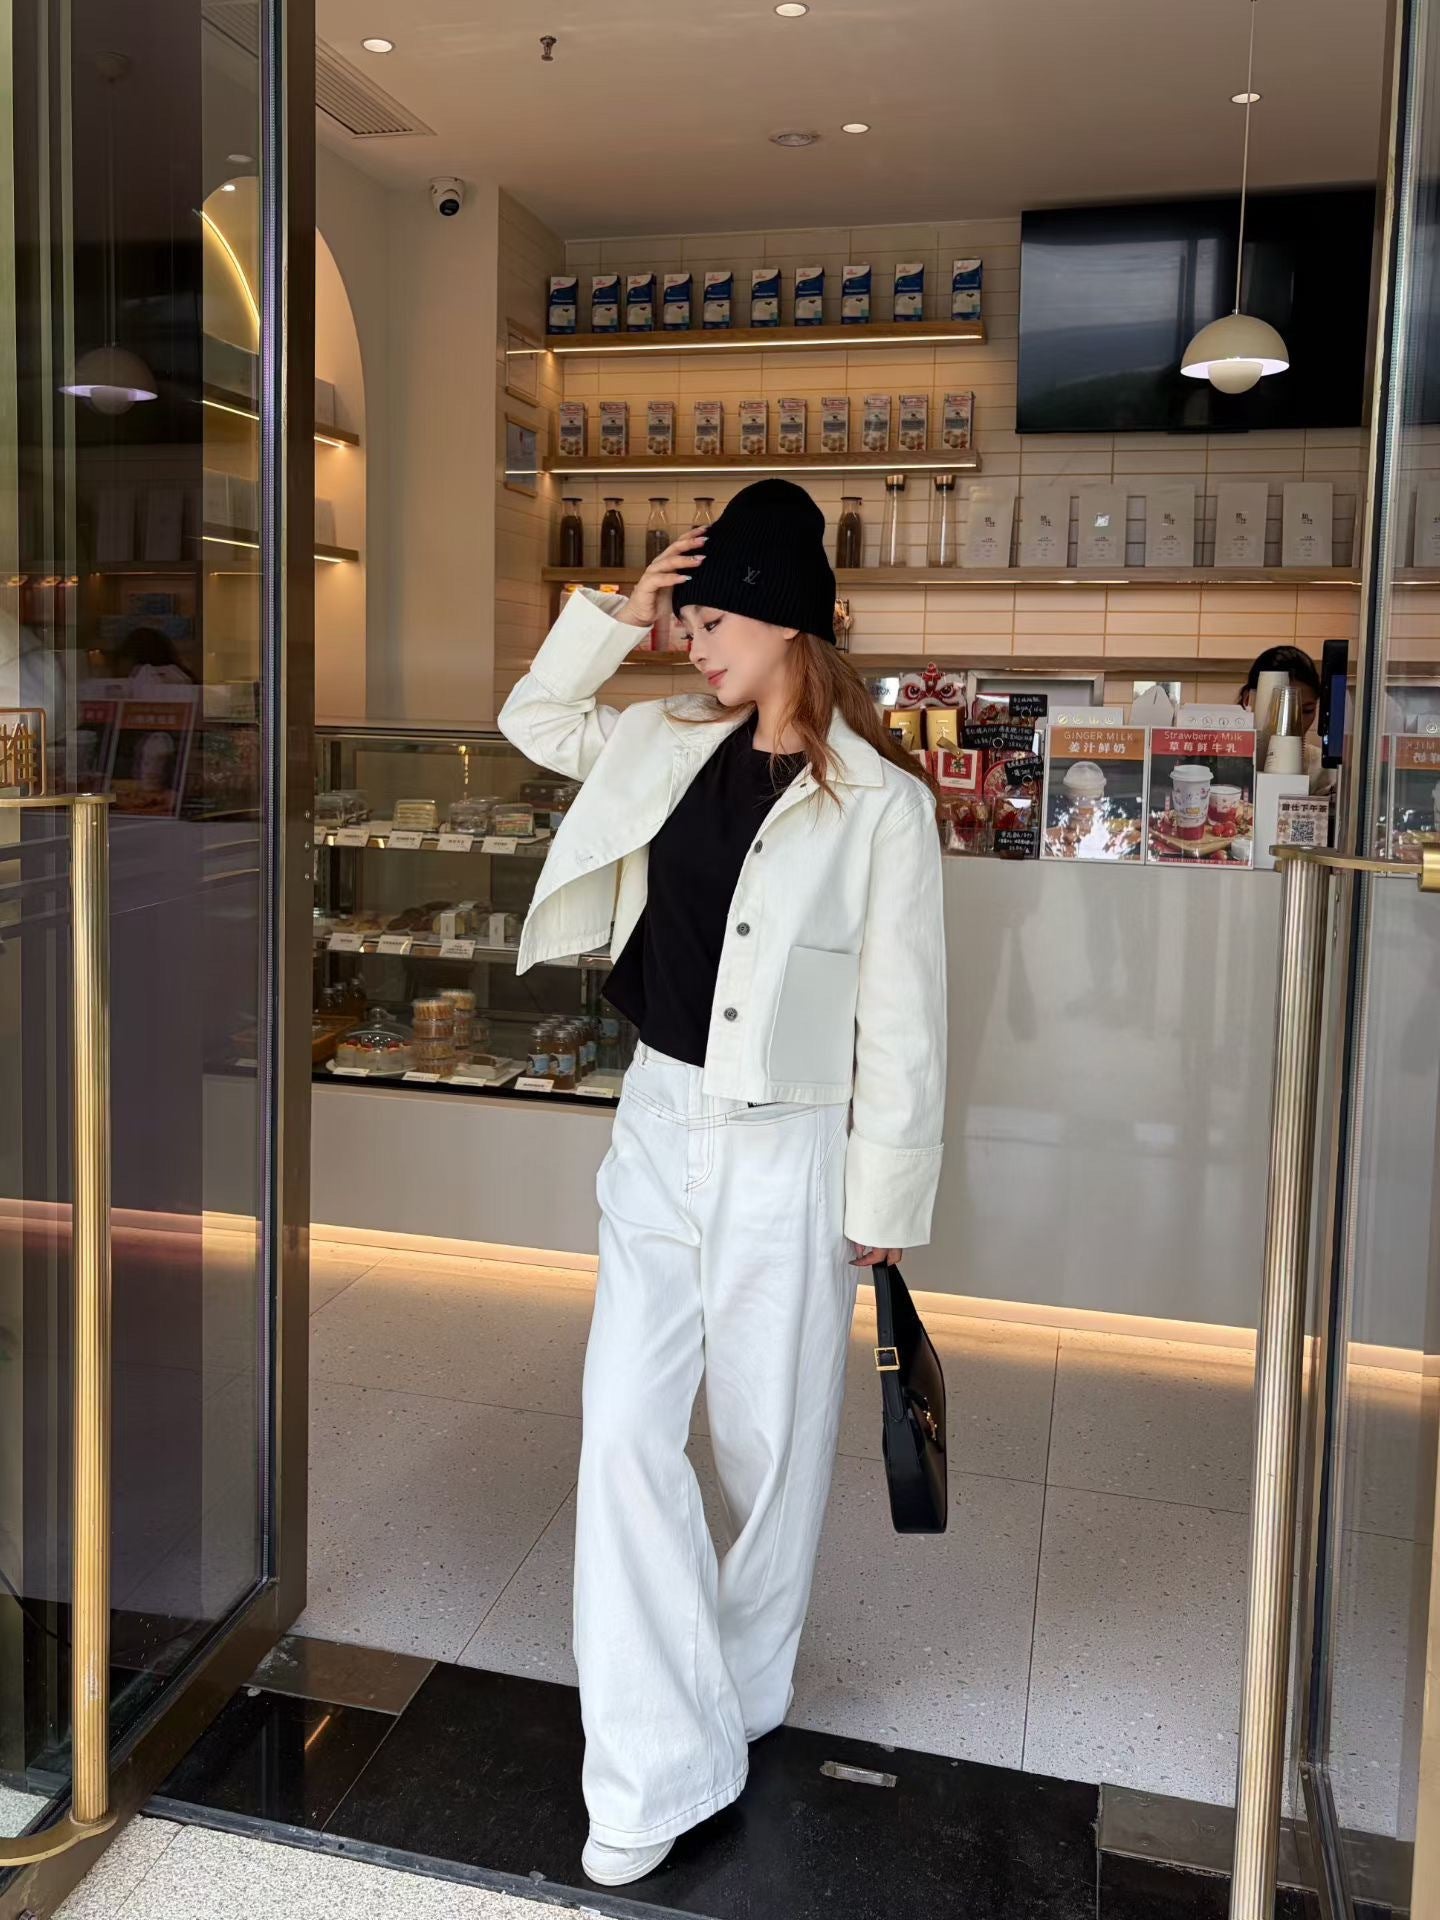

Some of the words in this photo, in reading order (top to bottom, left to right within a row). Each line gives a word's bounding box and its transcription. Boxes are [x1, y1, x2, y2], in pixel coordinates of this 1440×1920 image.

[1063, 731, 1103, 741] GINGER
[1106, 732, 1134, 742] MILK
[1163, 731, 1219, 743] Strawberry
[1221, 731, 1243, 742] Milk
[1068, 741, 1127, 754] 姜汁鲜奶
[1168, 740, 1238, 754] 草莓鲜牛乳
